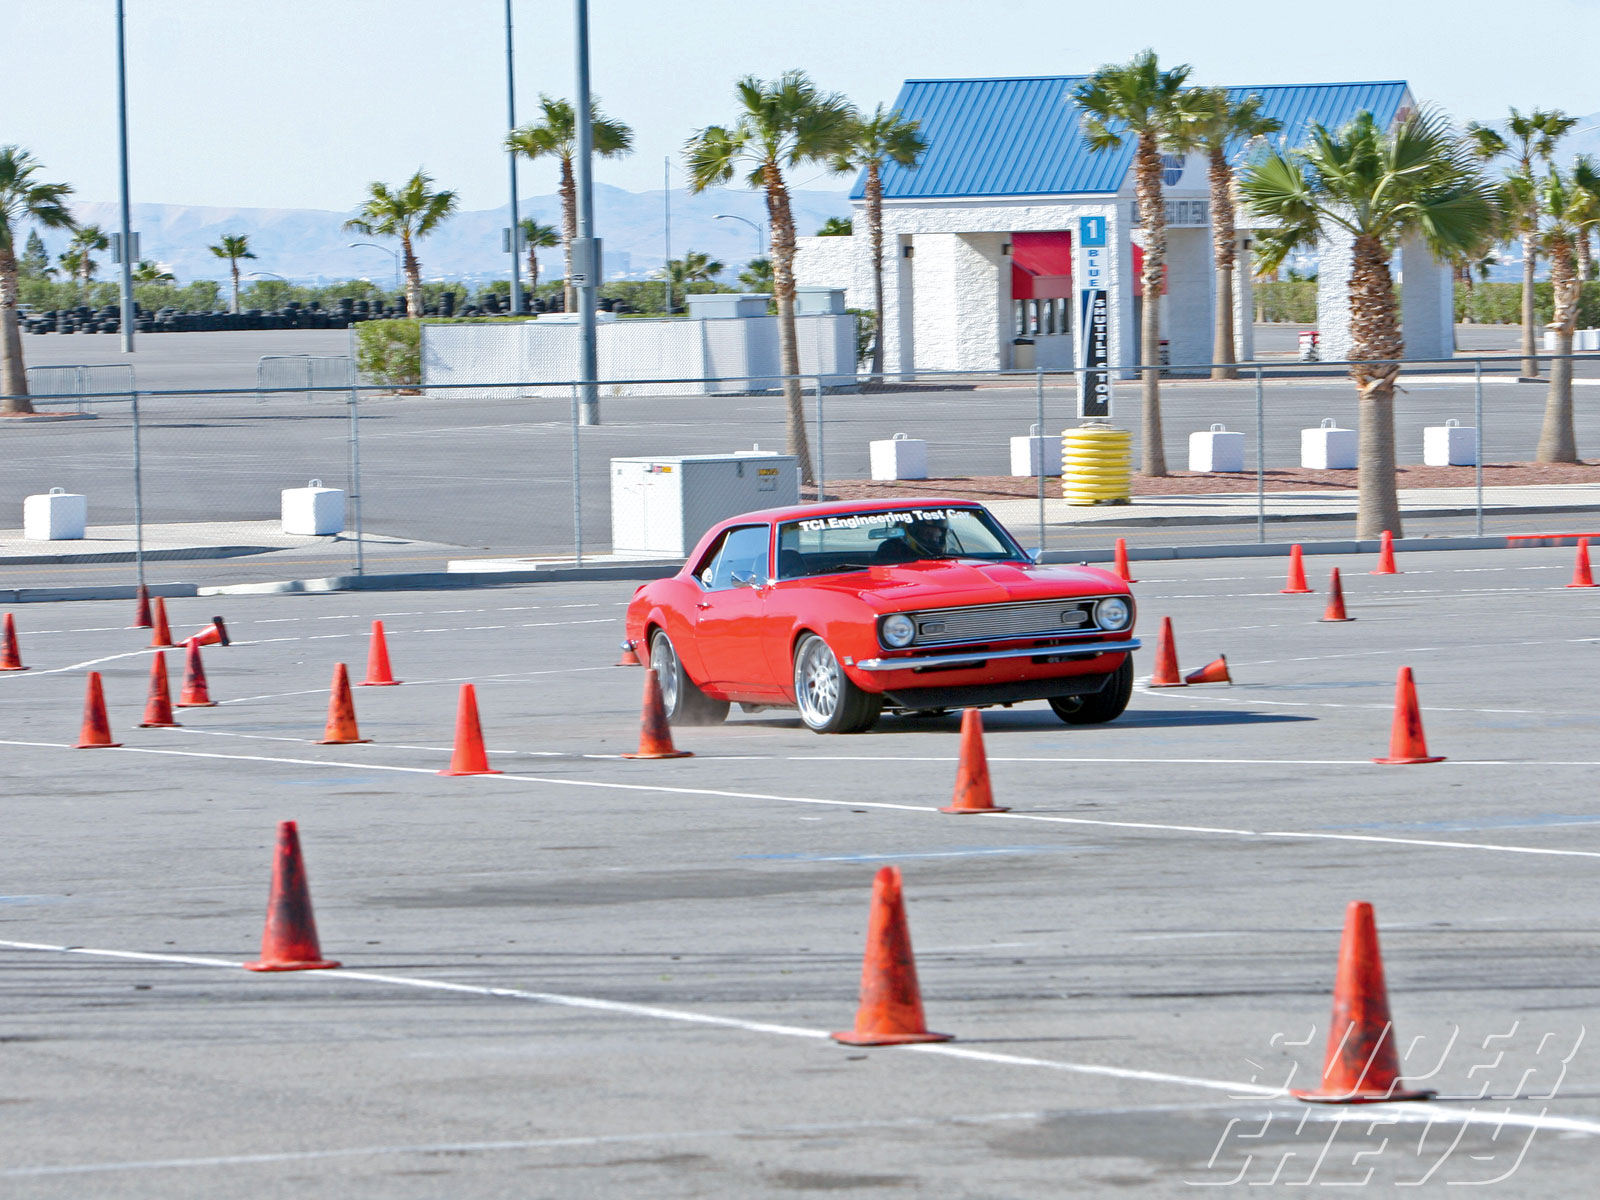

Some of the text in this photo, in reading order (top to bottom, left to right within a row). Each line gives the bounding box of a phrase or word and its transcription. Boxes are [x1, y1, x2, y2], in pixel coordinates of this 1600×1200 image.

[1087, 219, 1097, 239] 1
[1088, 249, 1100, 287] BLUE
[1093, 298, 1107, 358] SHUTTLE
[799, 508, 971, 532] TCI Engineering Test Car
